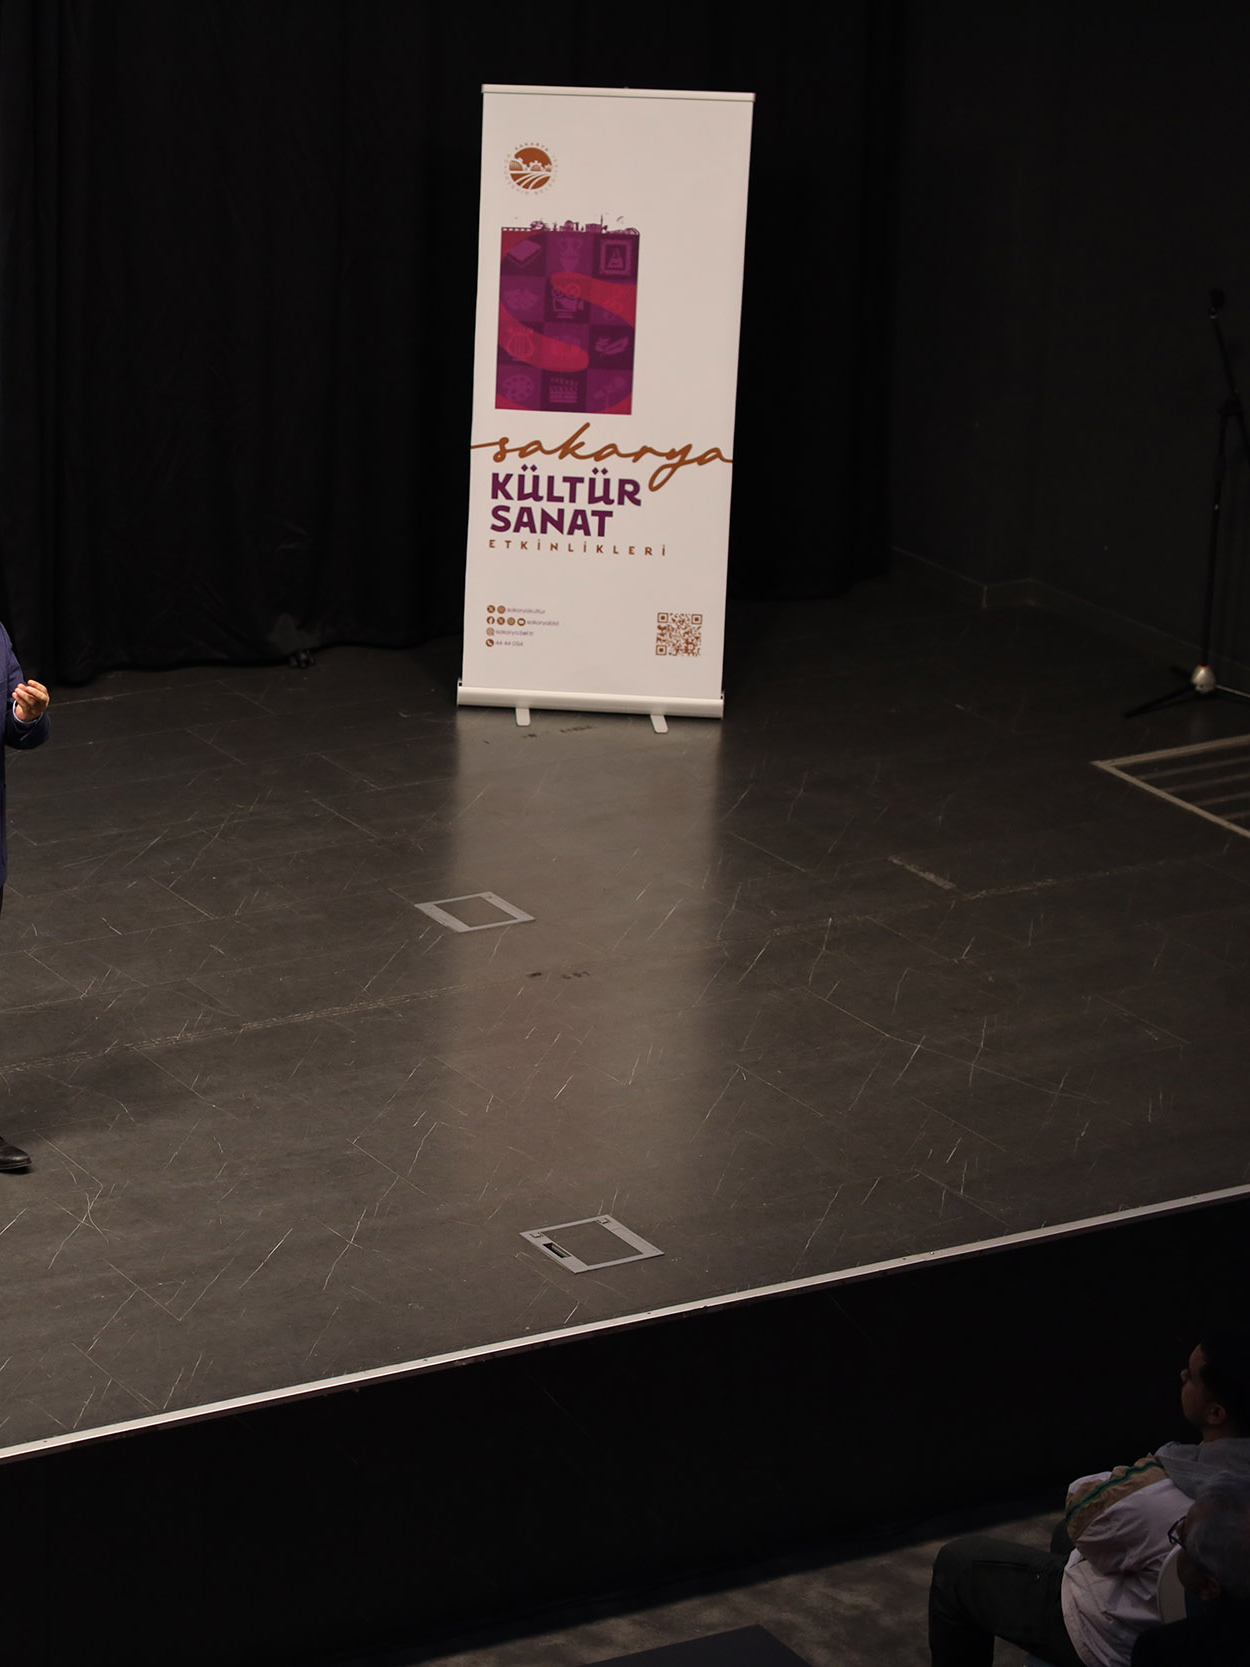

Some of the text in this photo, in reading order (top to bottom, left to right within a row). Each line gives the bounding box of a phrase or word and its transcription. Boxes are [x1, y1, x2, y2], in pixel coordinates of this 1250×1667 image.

[470, 422, 734, 492] sakarya
[490, 464, 643, 507] KÜLTÜR
[489, 505, 614, 537] SANAT
[488, 539, 667, 557] ETKİNLİKLERİ
